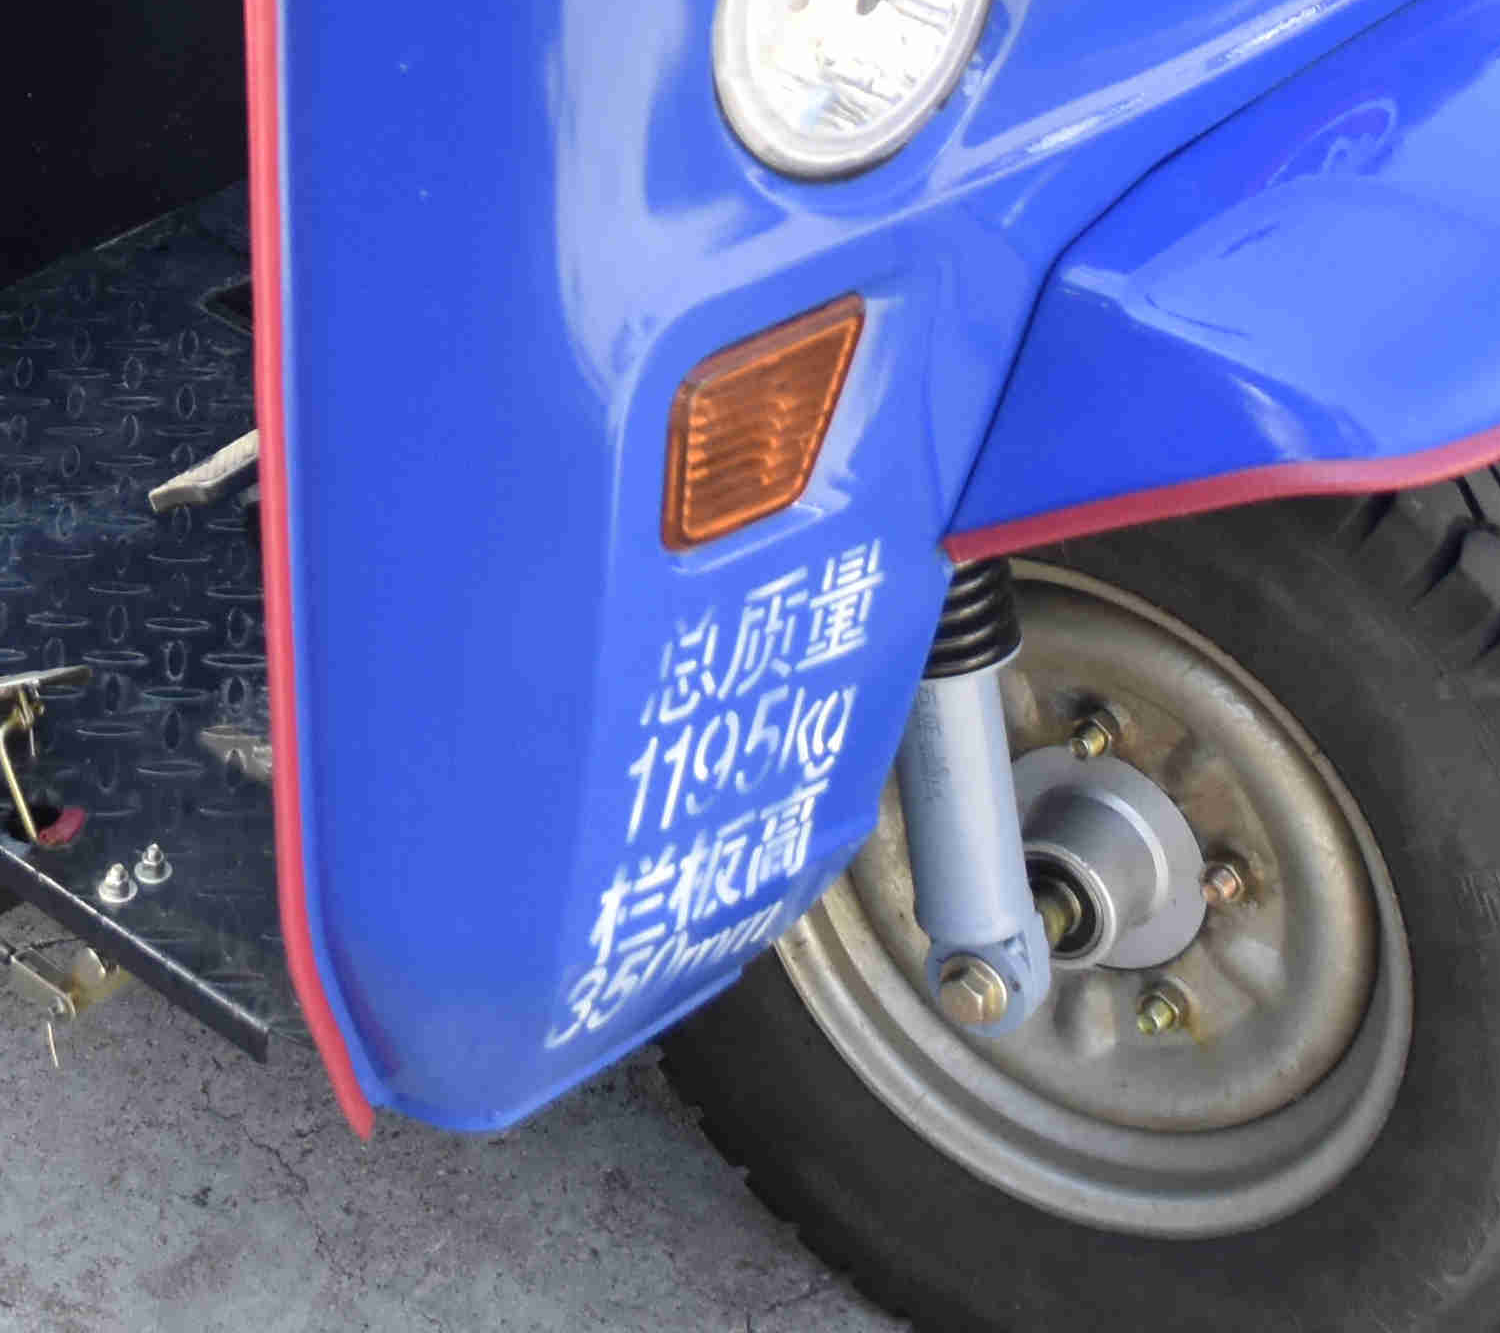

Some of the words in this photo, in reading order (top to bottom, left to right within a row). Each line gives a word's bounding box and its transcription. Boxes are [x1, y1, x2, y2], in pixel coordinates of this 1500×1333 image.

[640, 538, 884, 725] 总质量
[626, 685, 857, 844] 1195kg
[588, 778, 829, 967] 栏板高
